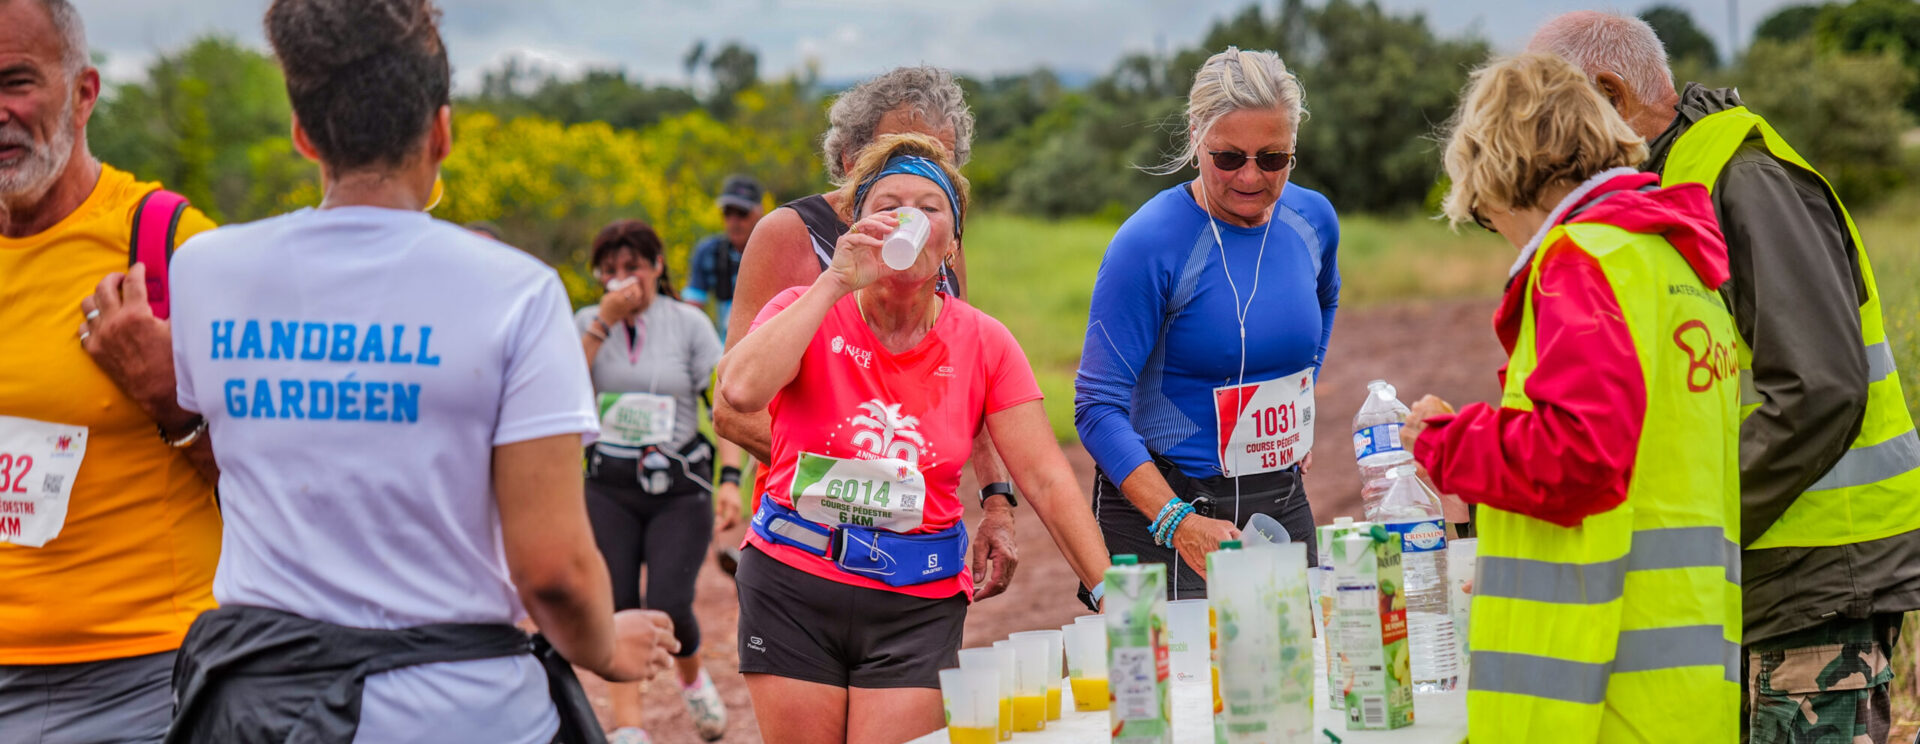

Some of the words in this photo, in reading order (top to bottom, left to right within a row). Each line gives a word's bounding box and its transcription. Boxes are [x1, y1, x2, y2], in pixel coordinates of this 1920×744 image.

[210, 319, 441, 366] HANDBALL
[845, 344, 871, 368] NCE
[224, 371, 421, 423] GARDÉEN
[1251, 400, 1297, 438] 1031
[1246, 440, 1275, 454] COURSE
[1276, 432, 1300, 450] PÉDESTRE
[1261, 452, 1277, 469] 13
[1280, 446, 1294, 466] KM
[826, 478, 891, 508] 6014
[820, 498, 851, 512] COURSE
[852, 506, 893, 518] PÉDESTRE
[839, 511, 848, 524] 6
[851, 514, 874, 527] KM
